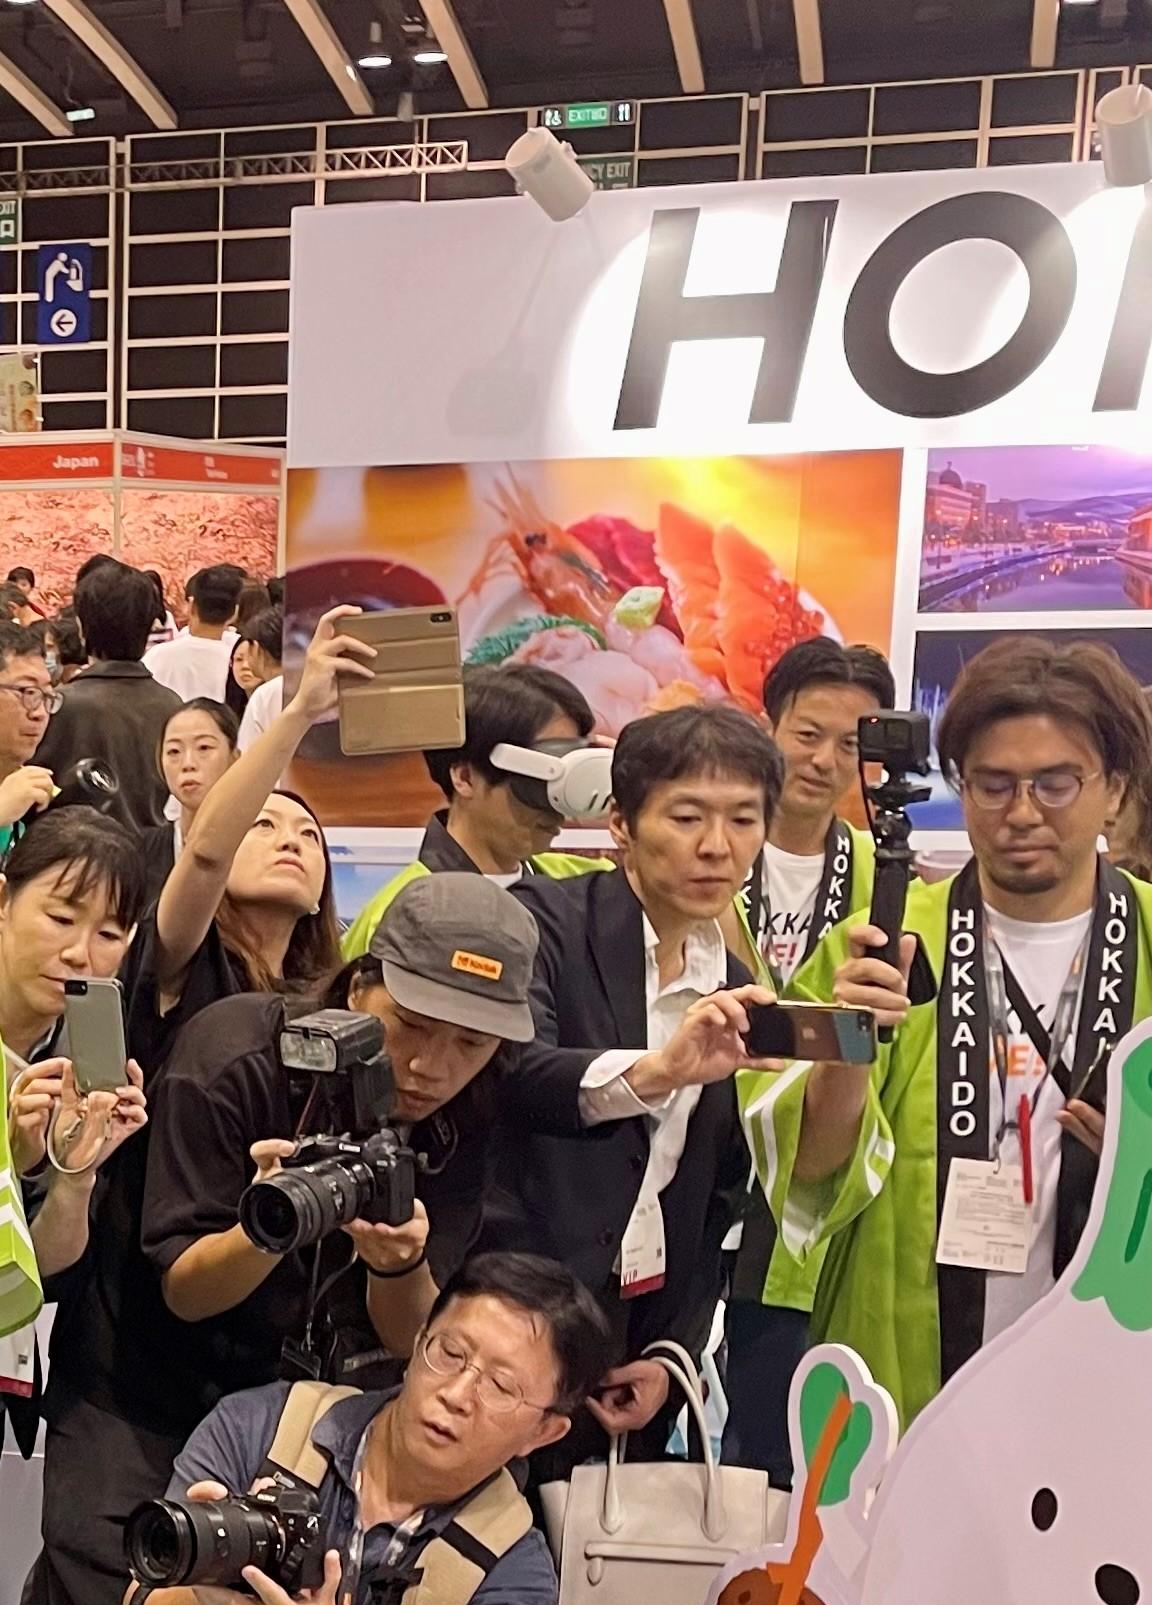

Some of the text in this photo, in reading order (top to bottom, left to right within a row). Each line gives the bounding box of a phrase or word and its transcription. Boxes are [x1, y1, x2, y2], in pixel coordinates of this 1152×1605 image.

[607, 162, 631, 178] EXIT
[52, 455, 99, 470] Japan
[818, 834, 851, 940] HOKKA
[950, 908, 977, 1137] HOKKAIDO
